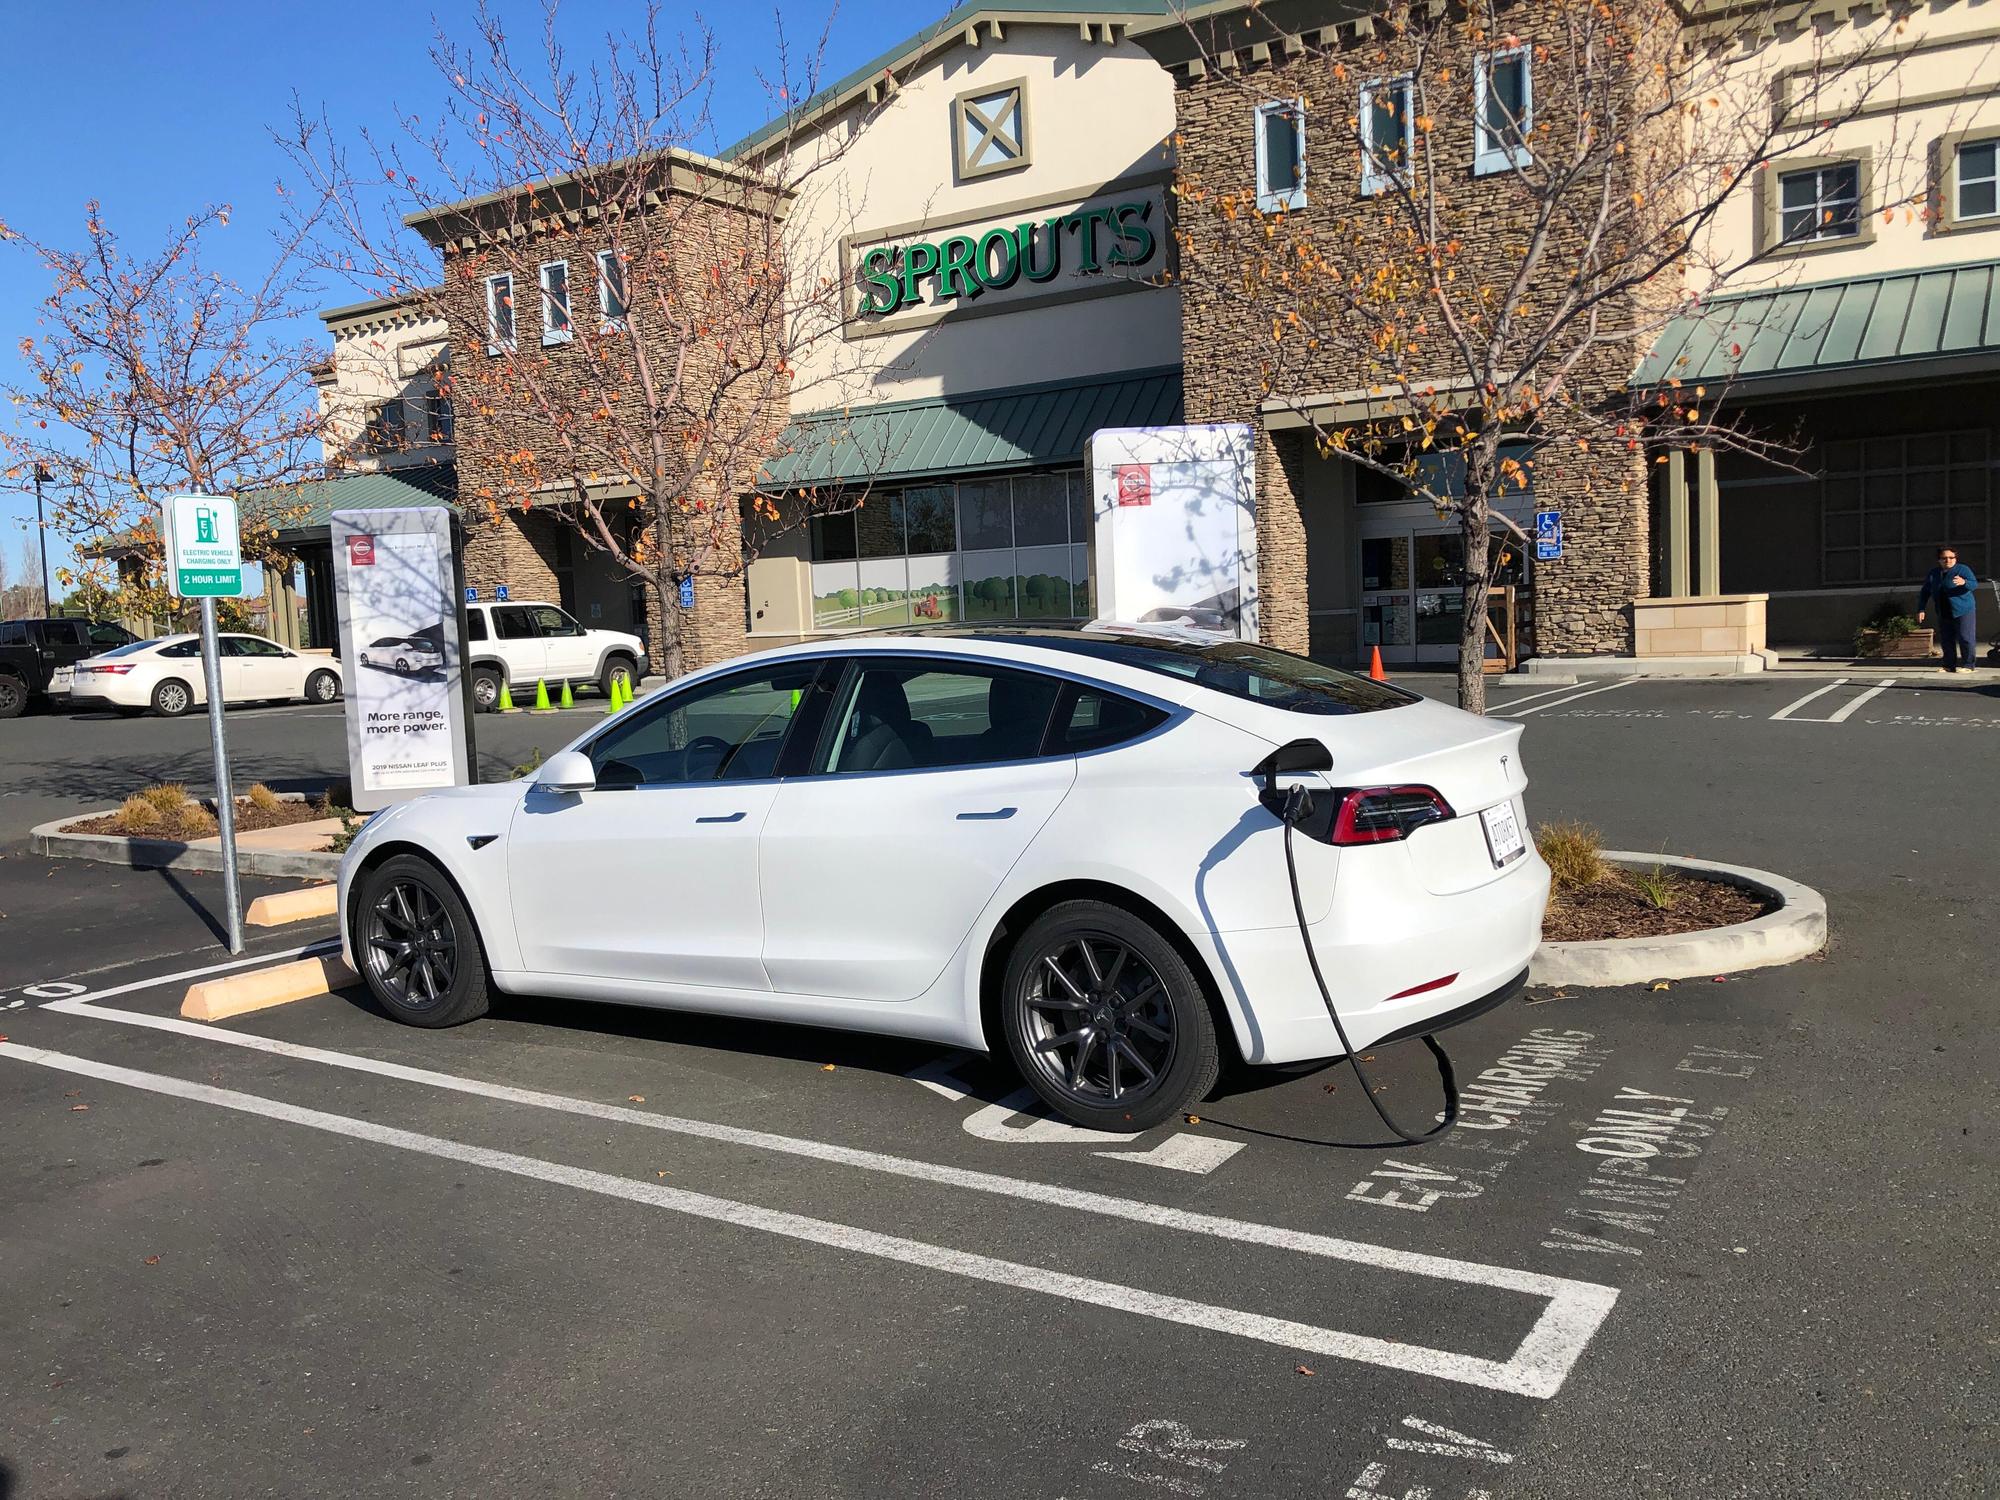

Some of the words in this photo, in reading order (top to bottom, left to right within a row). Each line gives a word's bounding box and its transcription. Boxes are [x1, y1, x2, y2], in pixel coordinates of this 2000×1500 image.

[860, 202, 1153, 314] SPROUTS
[184, 575, 190, 584] 2
[192, 575, 213, 584] HOUR
[215, 575, 236, 584] LIMIT
[367, 725, 400, 734] more
[403, 722, 447, 735] power.
[368, 712, 399, 722] More
[403, 711, 444, 721] range,
[1344, 1159, 1459, 1213] EV
[1435, 1028, 1596, 1130] CHARGING
[1575, 1086, 1695, 1159] ONLY
